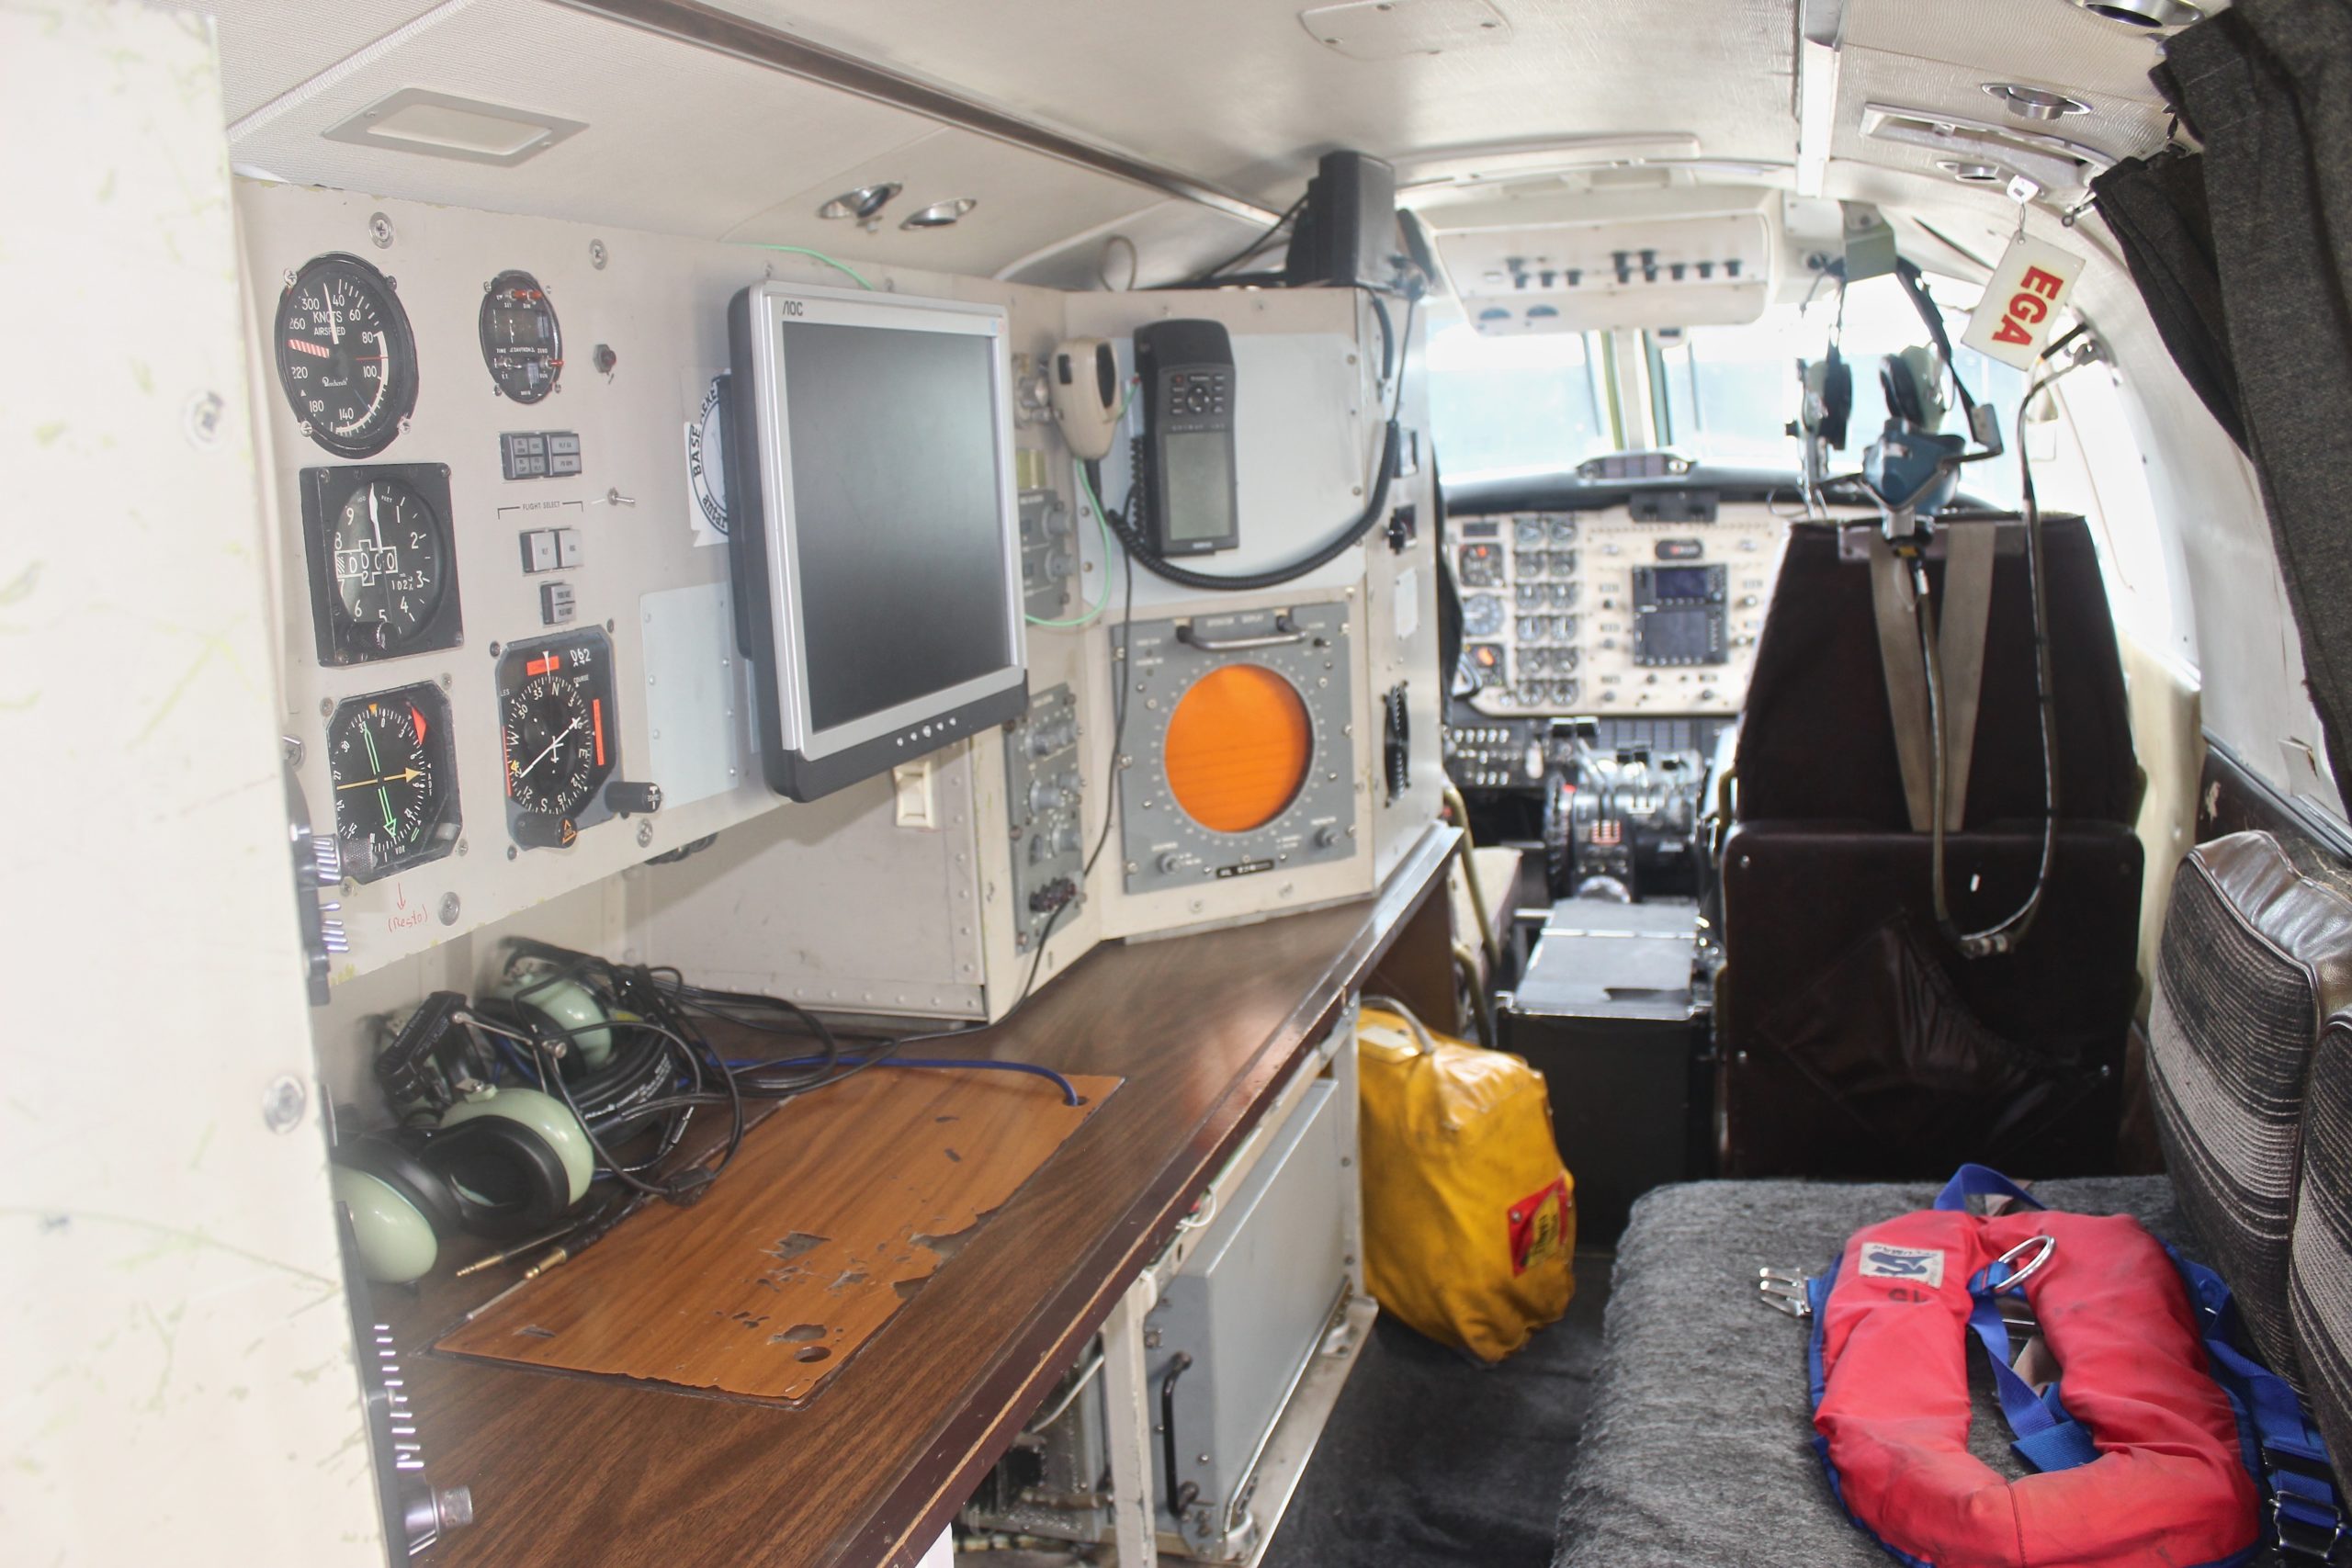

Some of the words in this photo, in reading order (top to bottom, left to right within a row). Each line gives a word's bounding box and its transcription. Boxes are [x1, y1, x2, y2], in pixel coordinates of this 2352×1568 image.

[301, 299, 319, 310] 300
[333, 295, 345, 306] 40
[1992, 265, 2064, 345] EGA
[782, 300, 803, 316] AOC
[349, 310, 361, 321] 60
[313, 327, 345, 336] AIRSPED
[362, 332, 374, 344] 80
[363, 366, 377, 378] 100
[310, 400, 323, 412] 180
[339, 408, 354, 420] 140
[690, 424, 702, 478] BASE
[522, 502, 541, 511] FLIGHT
[543, 501, 560, 510] SELECT
[346, 507, 355, 525] 9
[395, 505, 401, 524] 1
[334, 532, 343, 550] 8
[411, 531, 419, 548] 2
[416, 570, 424, 588] 3
[355, 599, 362, 617] 6
[401, 596, 409, 613] 4
[533, 687, 543, 700] 33
[551, 682, 560, 696] N
[568, 698, 575, 706] 3
[518, 705, 528, 719] 30
[399, 729, 405, 738] 3
[507, 731, 519, 745] W
[341, 739, 350, 752] 30
[579, 749, 589, 760] E
[334, 771, 342, 781] 27
[571, 773, 581, 786] 12
[523, 786, 533, 799] 21
[557, 791, 566, 805] 15
[336, 799, 345, 811] 24
[540, 797, 548, 812] S
[395, 845, 405, 855] VOR
